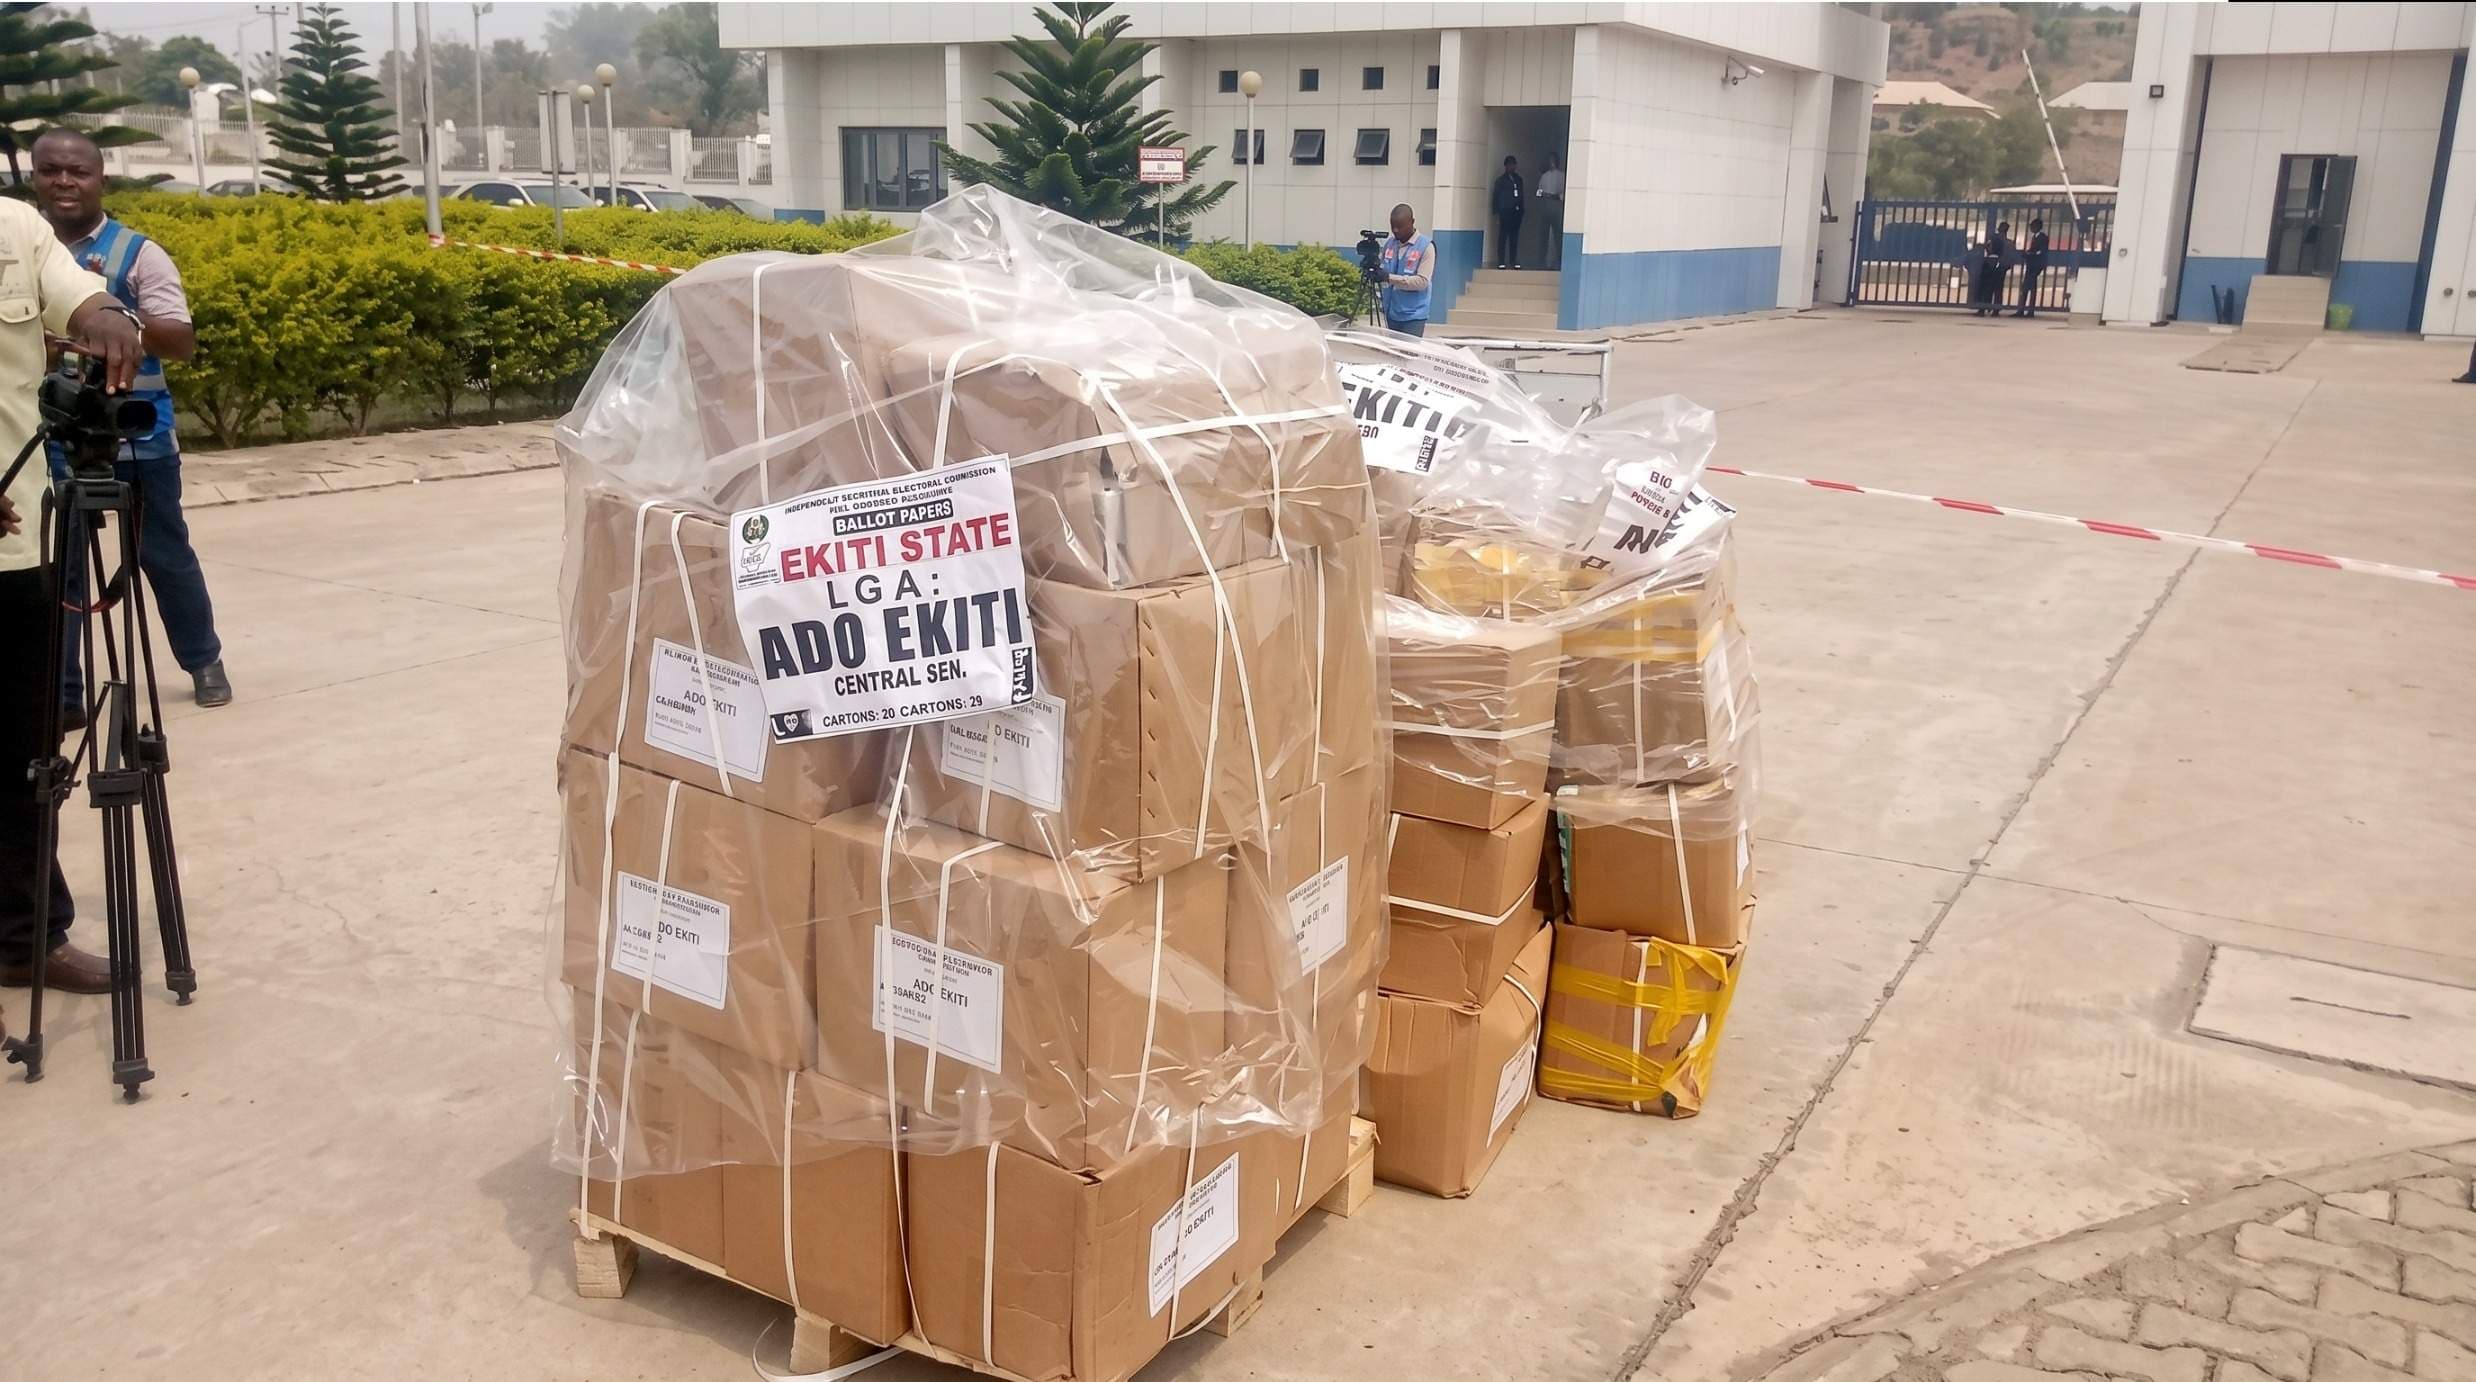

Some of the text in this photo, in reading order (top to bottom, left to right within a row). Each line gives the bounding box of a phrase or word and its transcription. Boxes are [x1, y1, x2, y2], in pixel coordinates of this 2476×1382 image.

[893, 479, 943, 495] ELECTORAL
[836, 500, 951, 534] BALLOT PAPERS
[781, 513, 1012, 582] EKITI STATE
[759, 612, 867, 680] ADO
[883, 588, 1023, 662] EKITI
[834, 659, 967, 697] CENTRAL SEN.
[684, 690, 707, 706] ADO
[823, 712, 880, 727] CARTONS:
[881, 708, 896, 720] 20
[900, 698, 967, 717] CARTONS:
[969, 695, 983, 708] 29
[1004, 729, 1031, 748] EKITI
[658, 921, 700, 945] DO EKITI
[941, 987, 968, 1008] EKITI
